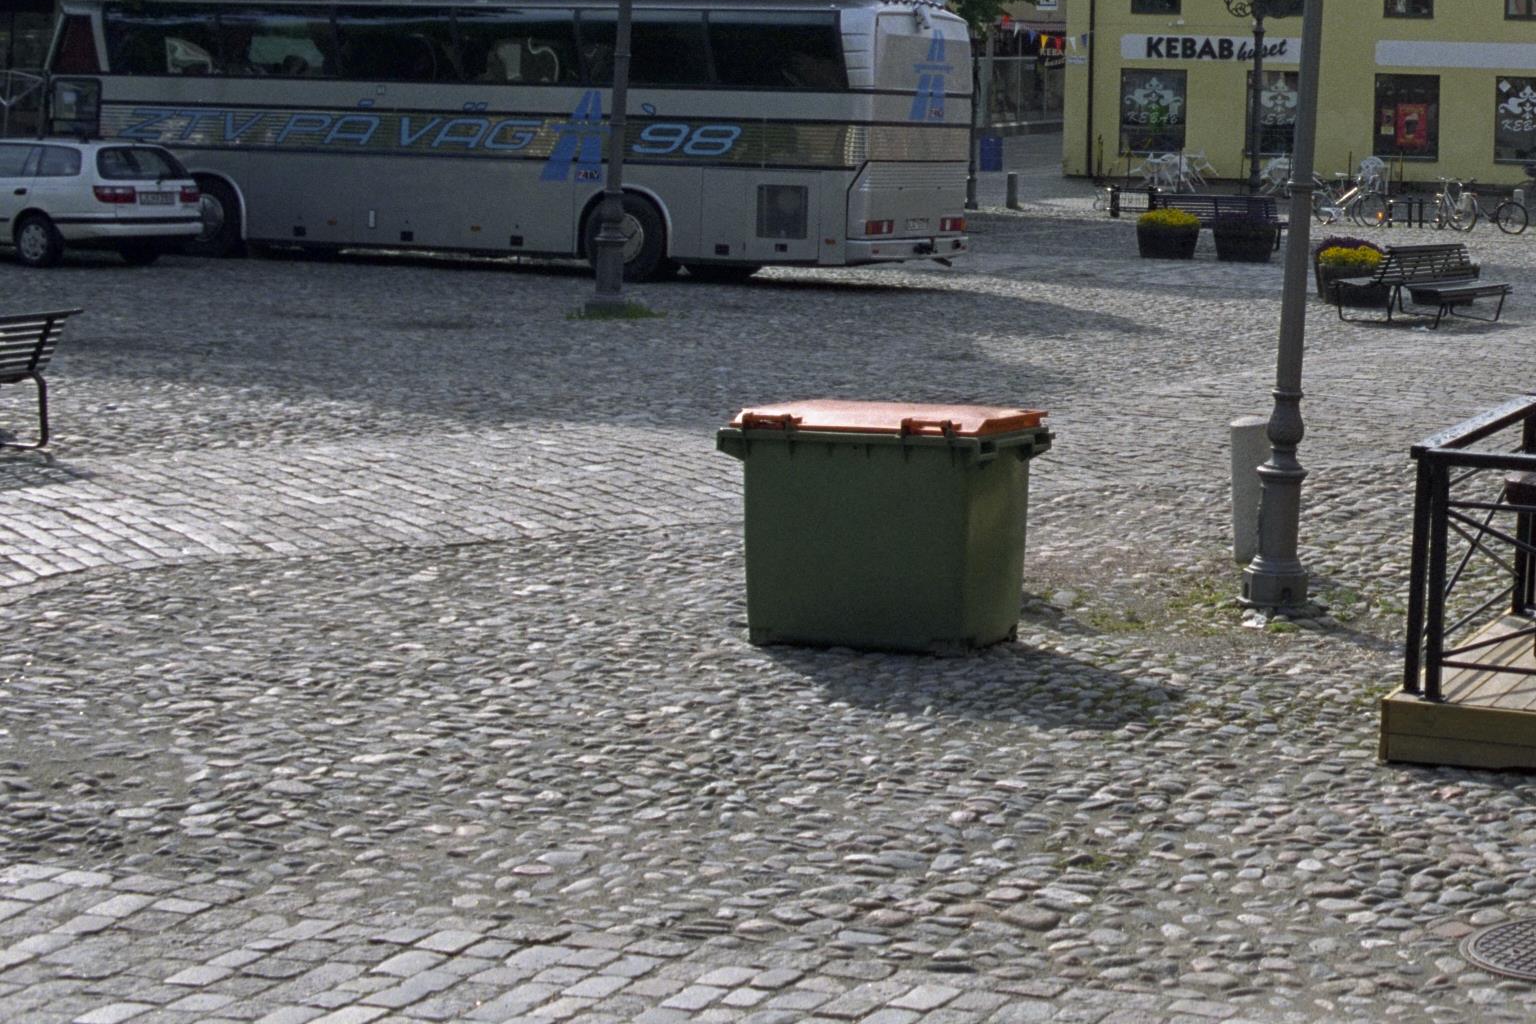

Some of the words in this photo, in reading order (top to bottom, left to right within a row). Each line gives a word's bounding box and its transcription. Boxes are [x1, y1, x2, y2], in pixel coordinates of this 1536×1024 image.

[1146, 37, 1234, 59] KEBAB
[118, 107, 265, 141] ZTV
[275, 99, 381, 145] PÅ
[399, 102, 544, 151] VÄG
